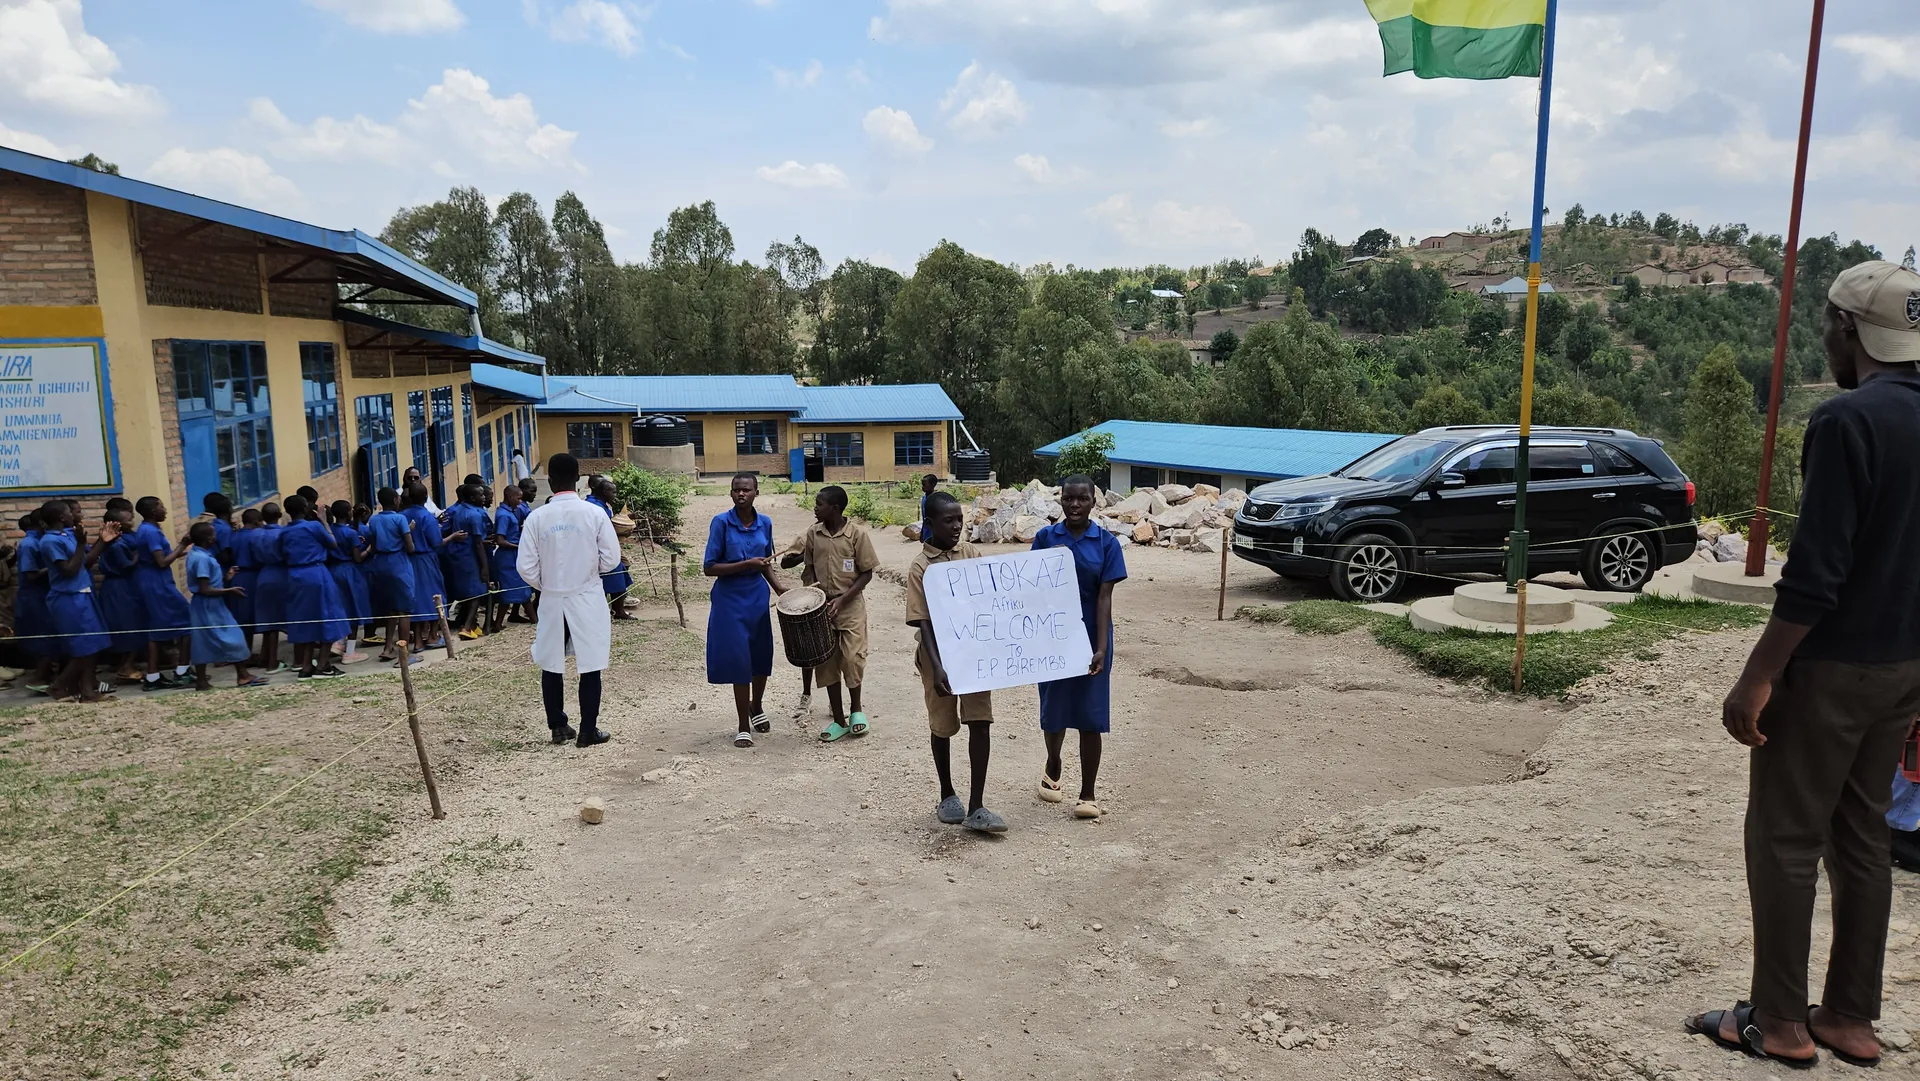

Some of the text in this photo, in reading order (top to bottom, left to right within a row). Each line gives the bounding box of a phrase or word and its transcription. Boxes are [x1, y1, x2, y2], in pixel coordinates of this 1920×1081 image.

[5, 413, 63, 428] UMWANDA
[0, 458, 20, 470] WA
[946, 554, 1069, 597] PUTOKAZ
[949, 612, 1068, 642] WELCOME
[1005, 643, 1023, 658] TO
[977, 655, 1066, 679] E.P BIREMBO
